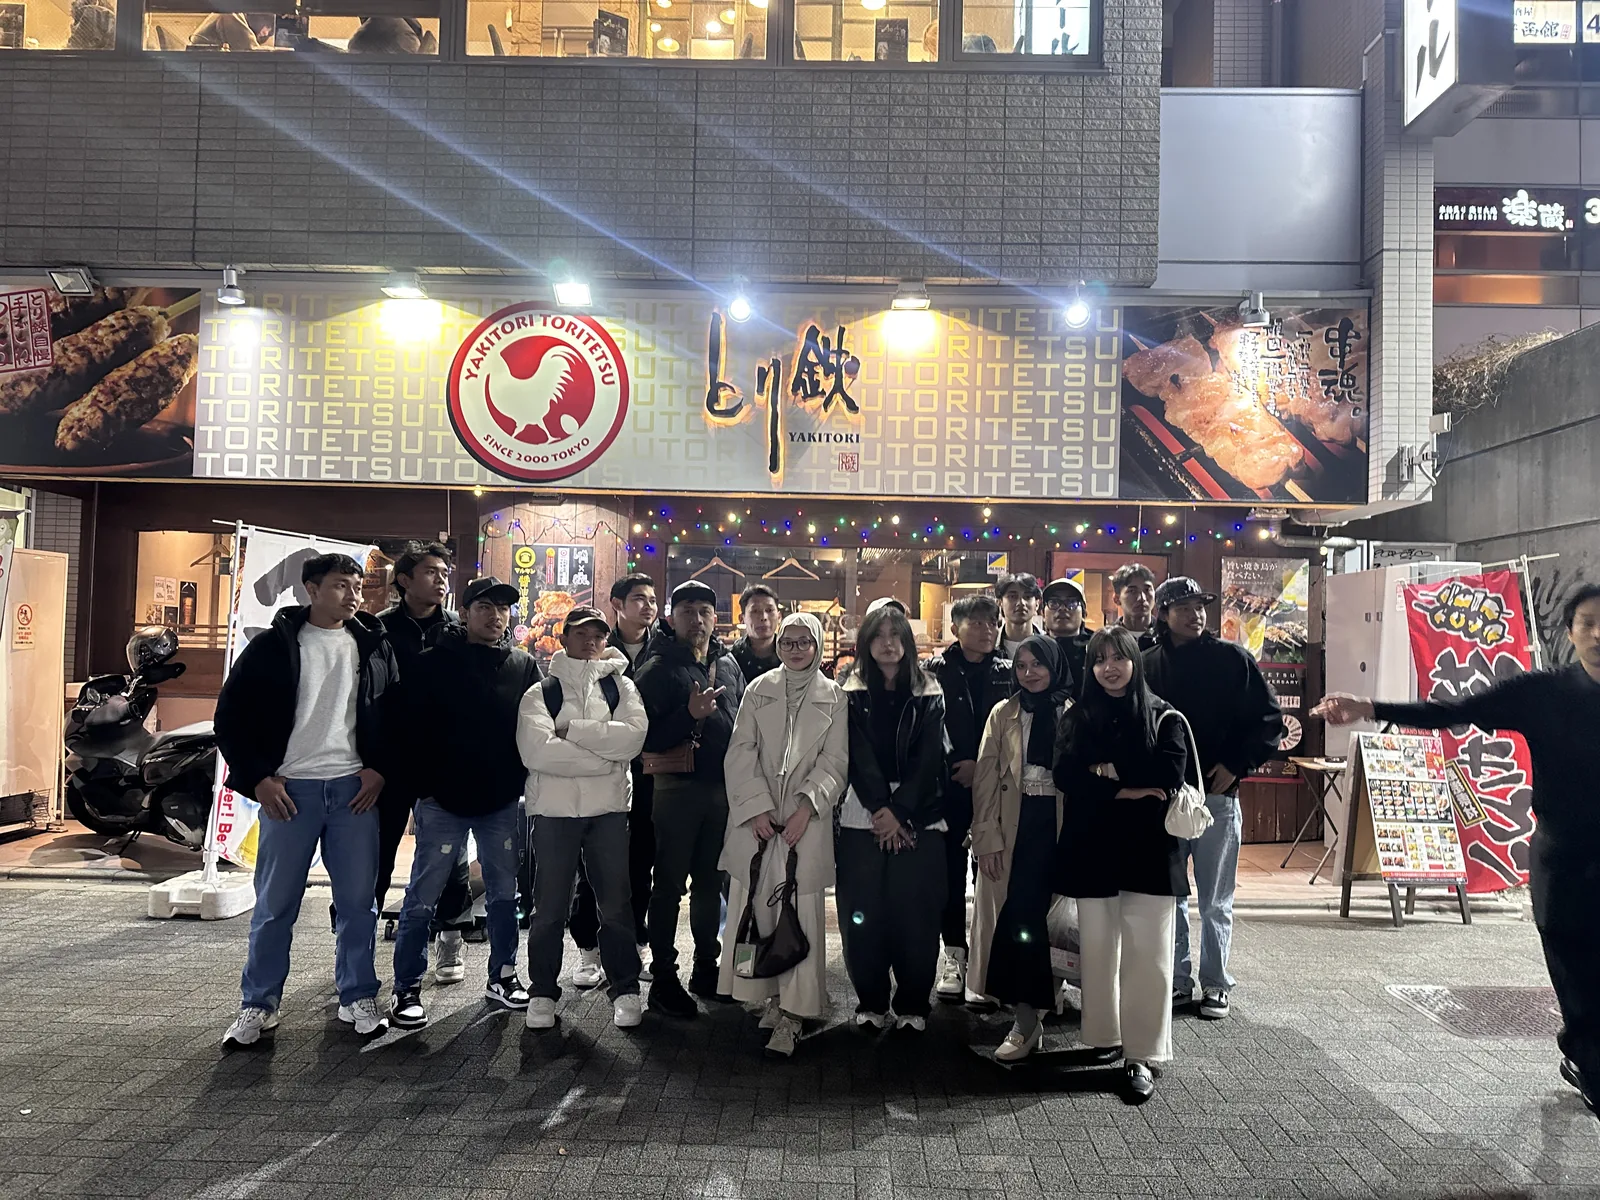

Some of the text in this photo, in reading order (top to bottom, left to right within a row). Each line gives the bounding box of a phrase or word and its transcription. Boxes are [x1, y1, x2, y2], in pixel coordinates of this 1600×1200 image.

[464, 314, 535, 381] YAKITORI
[539, 314, 615, 386] TORITETSU
[788, 431, 860, 443] YAKITORI
[483, 433, 590, 464] SINCE 2000 TOKYO
[1227, 561, 1278, 571] 旨い焼き鳥が
[1227, 571, 1264, 580] 食べたい。
